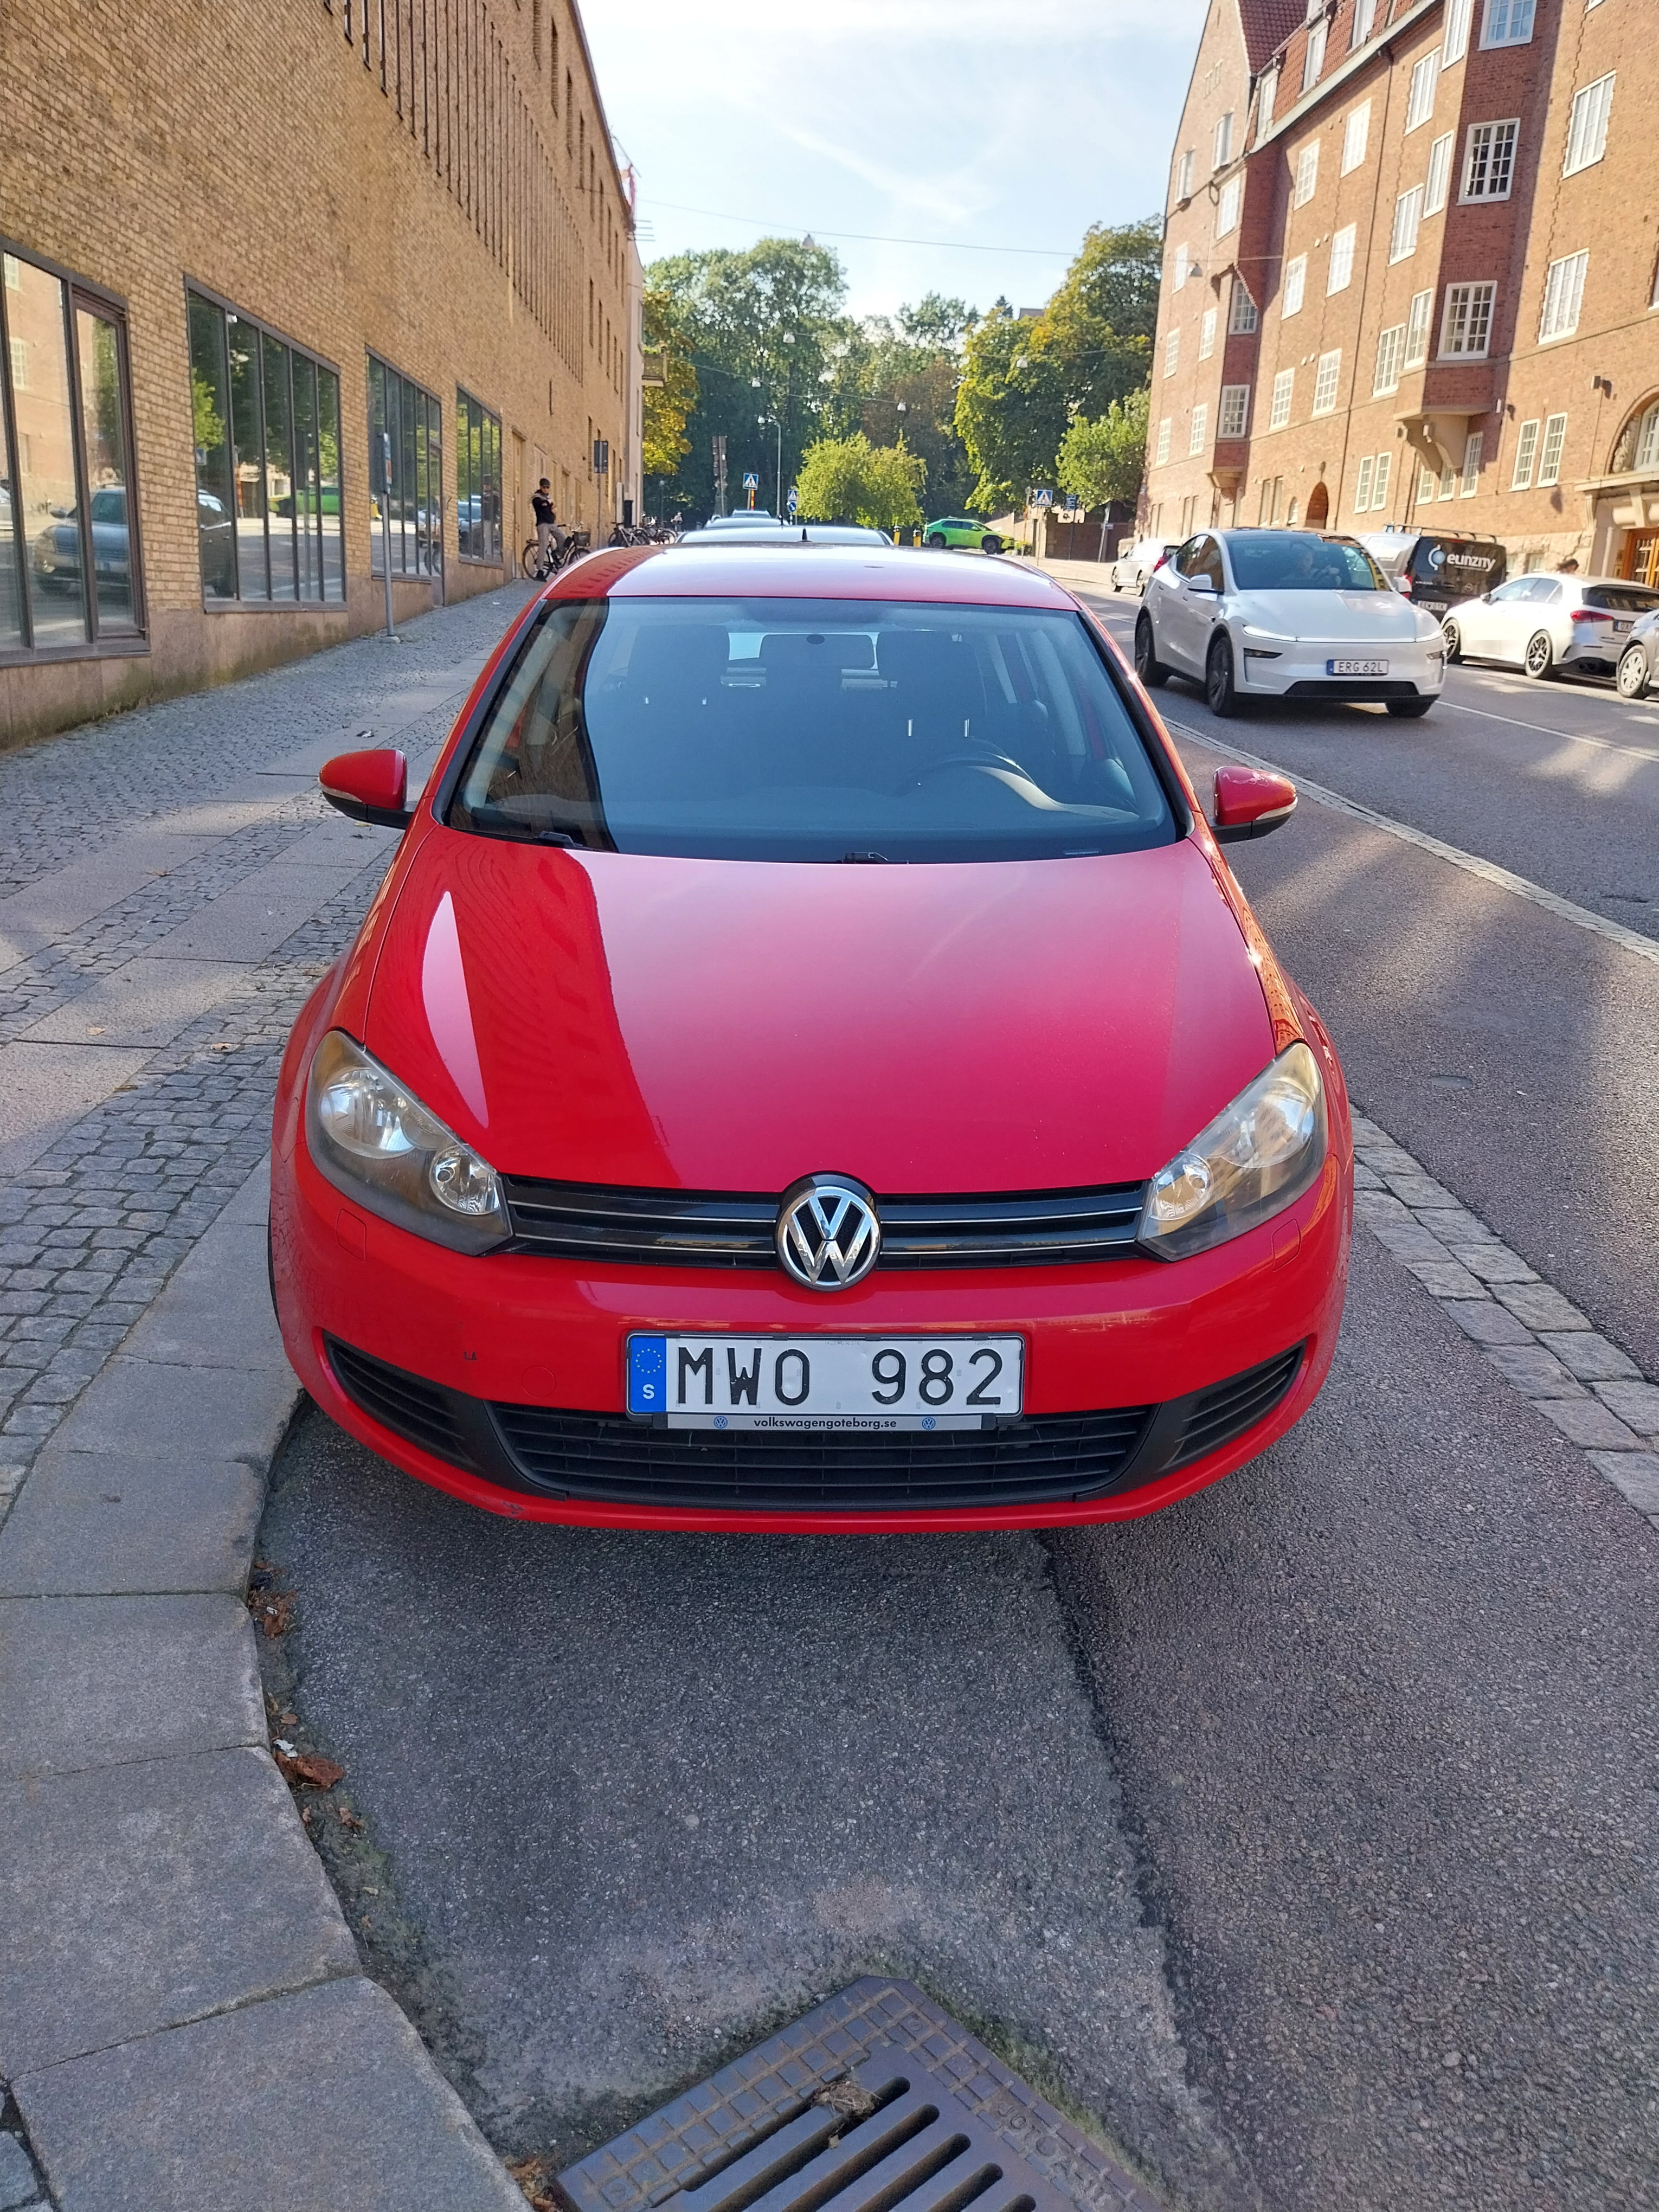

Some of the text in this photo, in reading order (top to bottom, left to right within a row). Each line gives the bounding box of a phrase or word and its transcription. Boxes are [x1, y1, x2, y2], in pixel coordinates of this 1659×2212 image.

[1339, 662, 1382, 672] ERG 62L
[781, 1189, 877, 1287] VW
[642, 1347, 1003, 1406] S MWO 982
[754, 1417, 897, 1430] volkswagengoteborg.se
